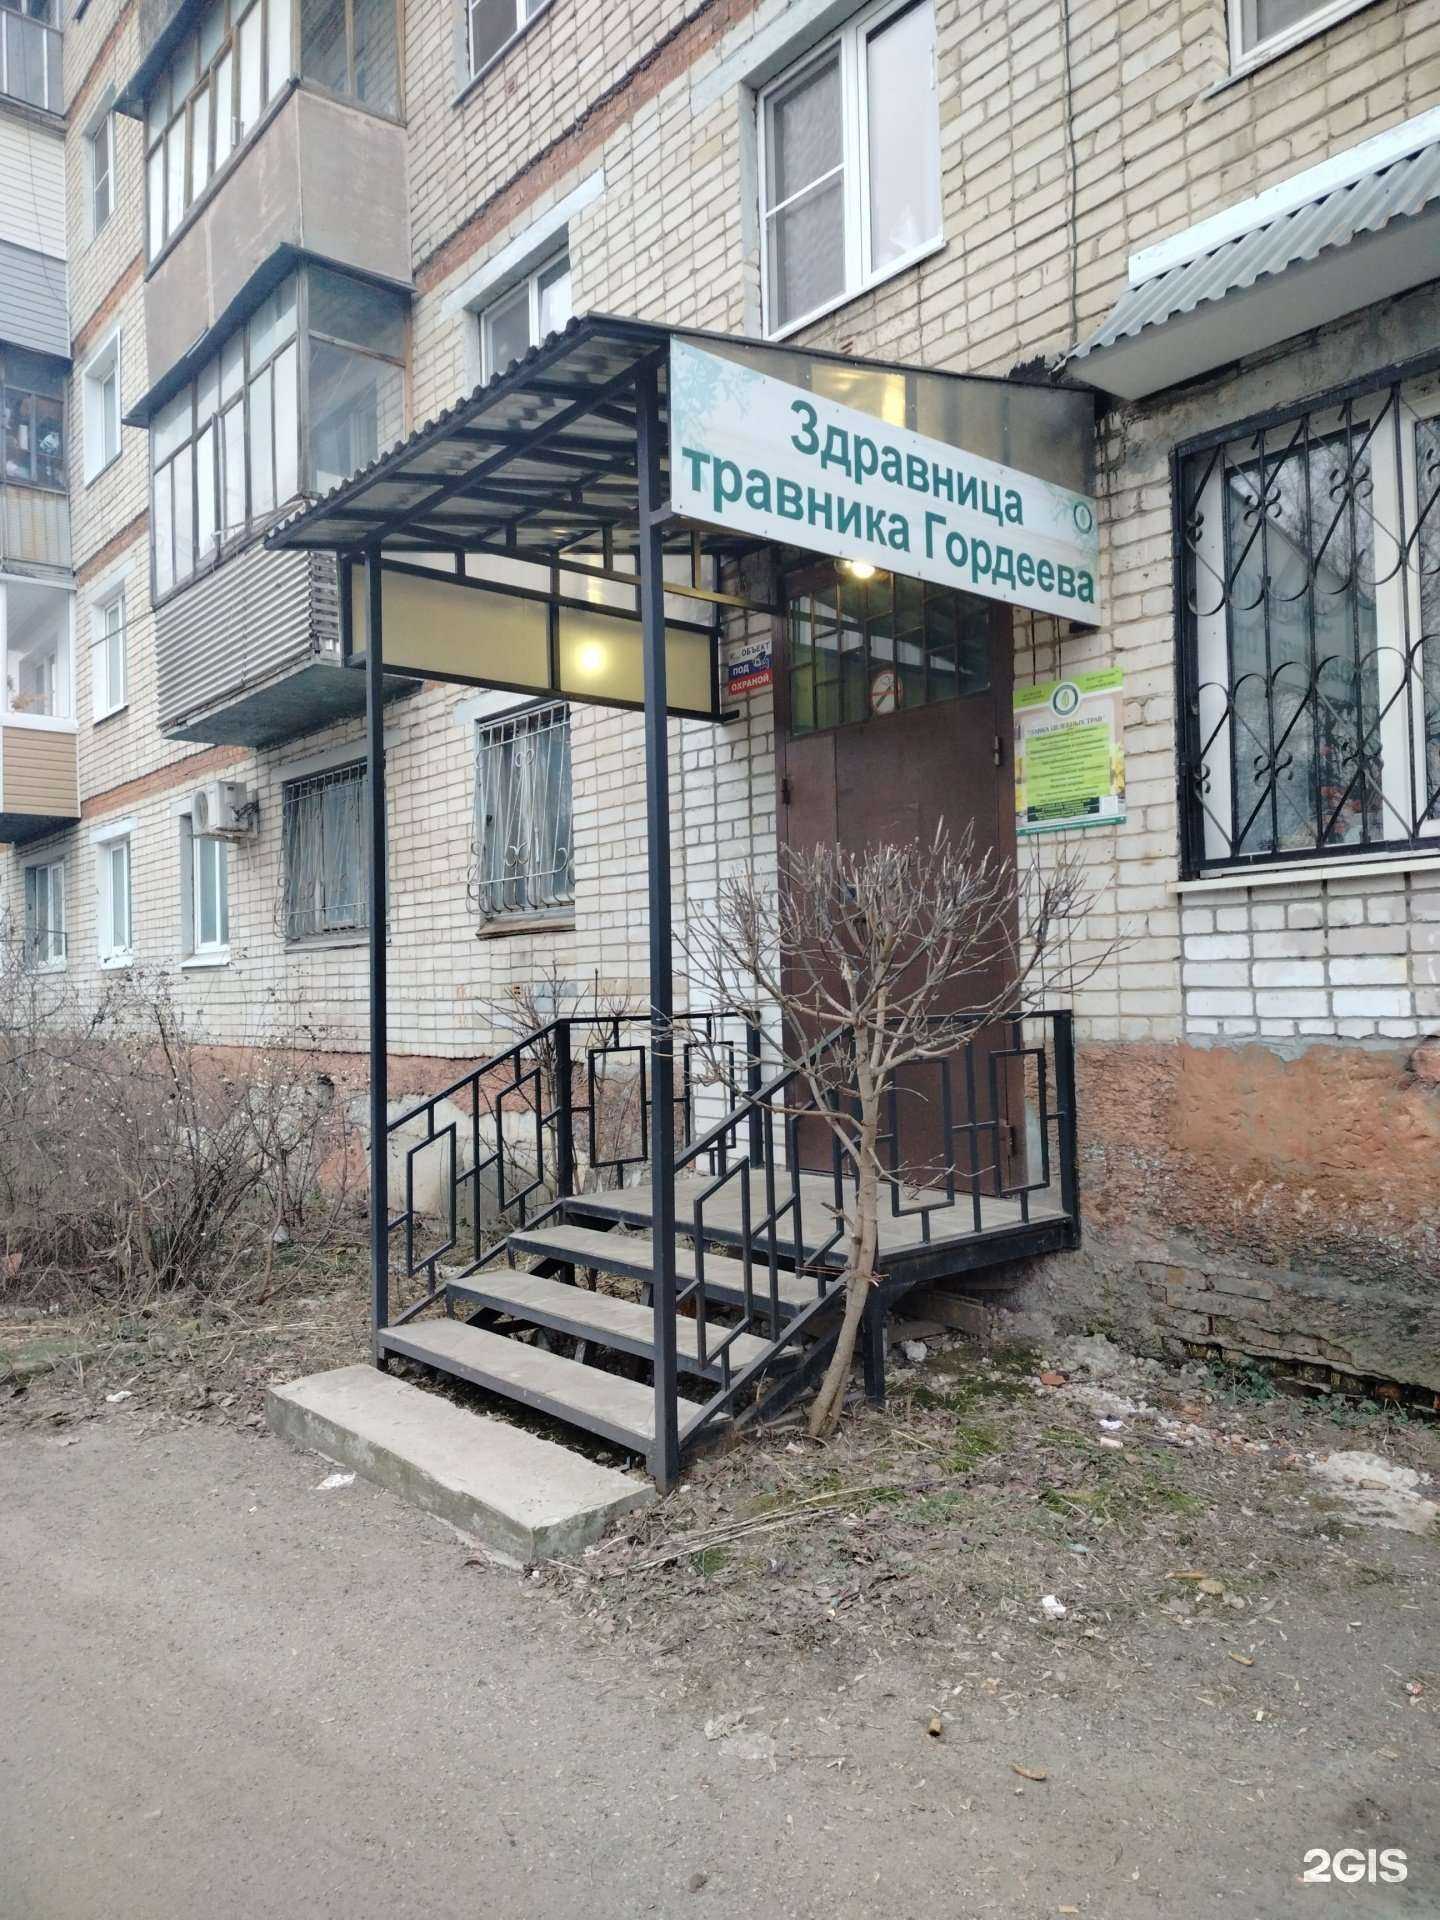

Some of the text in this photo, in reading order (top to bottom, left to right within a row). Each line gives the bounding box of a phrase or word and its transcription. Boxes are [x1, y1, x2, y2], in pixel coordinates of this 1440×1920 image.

[790, 400, 1024, 527] Здравница
[681, 447, 1095, 605] травника Гордеева
[731, 672, 769, 691] ОХРАНОЙ
[732, 664, 750, 676] ПОД
